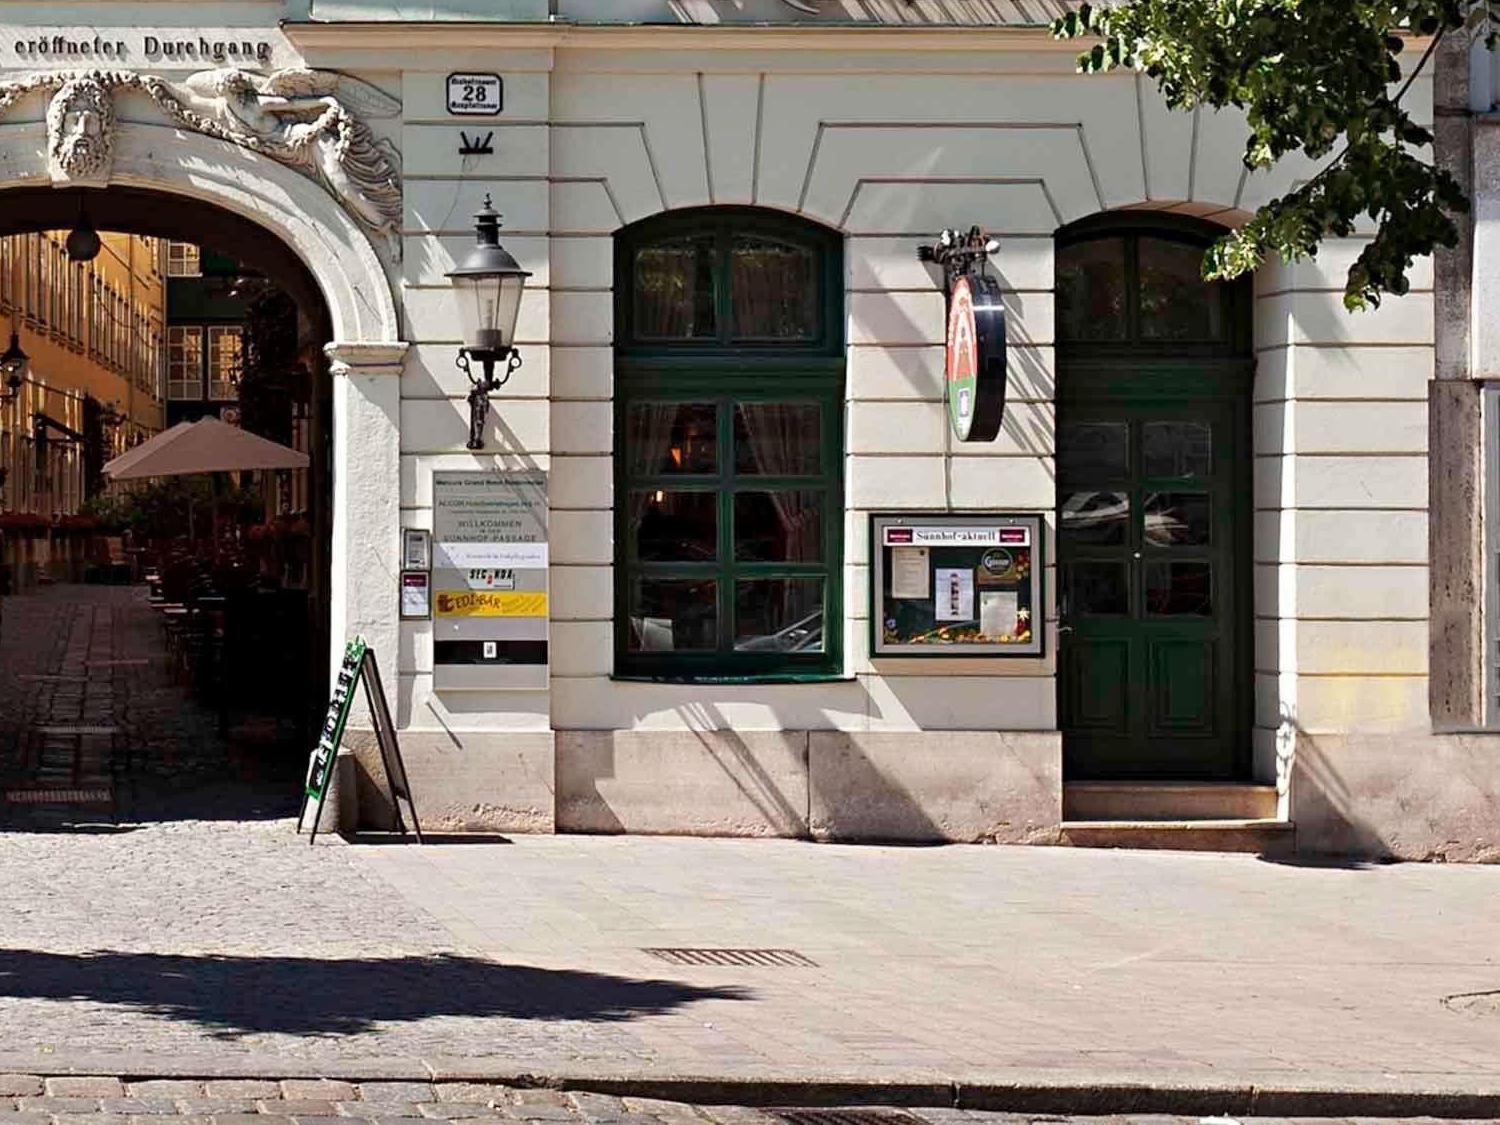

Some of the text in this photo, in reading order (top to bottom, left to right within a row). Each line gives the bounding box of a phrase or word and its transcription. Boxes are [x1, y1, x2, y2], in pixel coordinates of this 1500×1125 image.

[14, 36, 125, 55] eröffneter
[143, 36, 270, 62] Durchgang
[461, 85, 487, 103] 28
